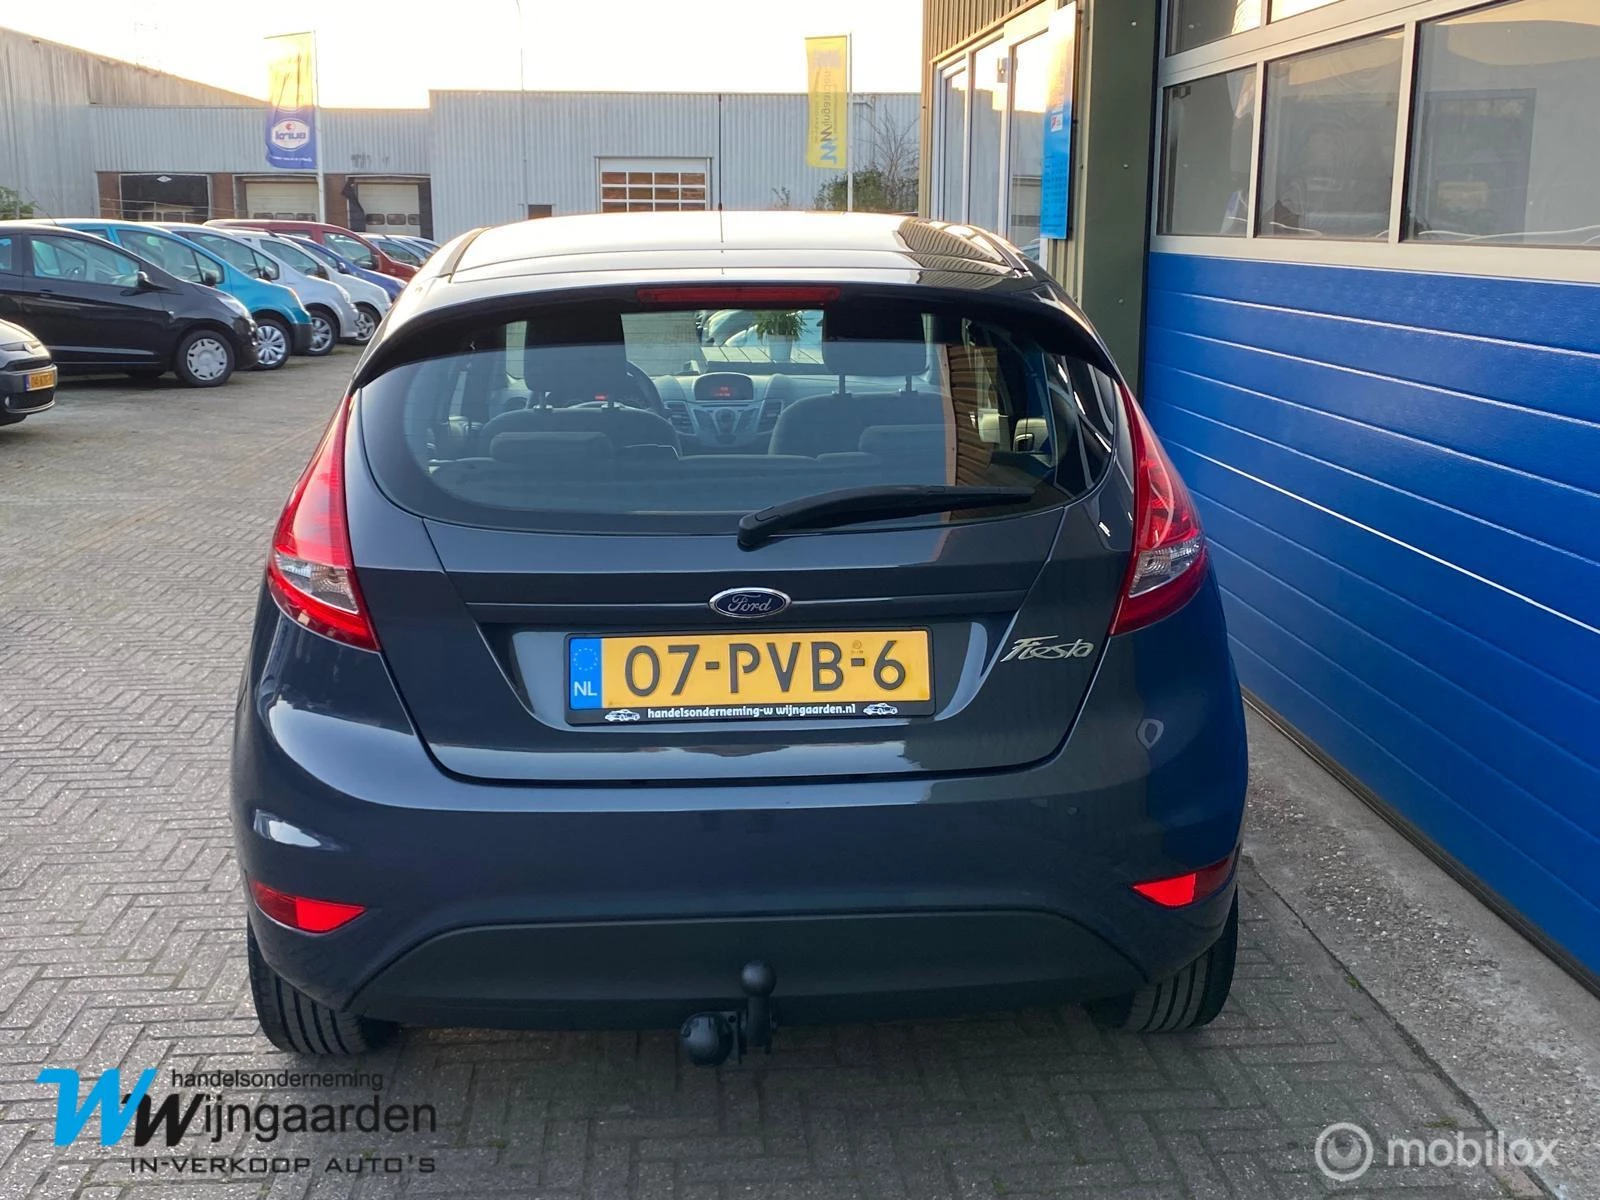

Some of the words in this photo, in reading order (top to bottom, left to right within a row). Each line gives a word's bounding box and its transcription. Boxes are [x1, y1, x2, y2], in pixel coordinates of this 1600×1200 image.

[725, 594, 775, 615] Ford
[1002, 635, 1094, 664] Fiesta
[625, 638, 905, 695] 07-PVB-6
[574, 682, 597, 697] NL
[776, 703, 856, 718] wijngaarden.nl
